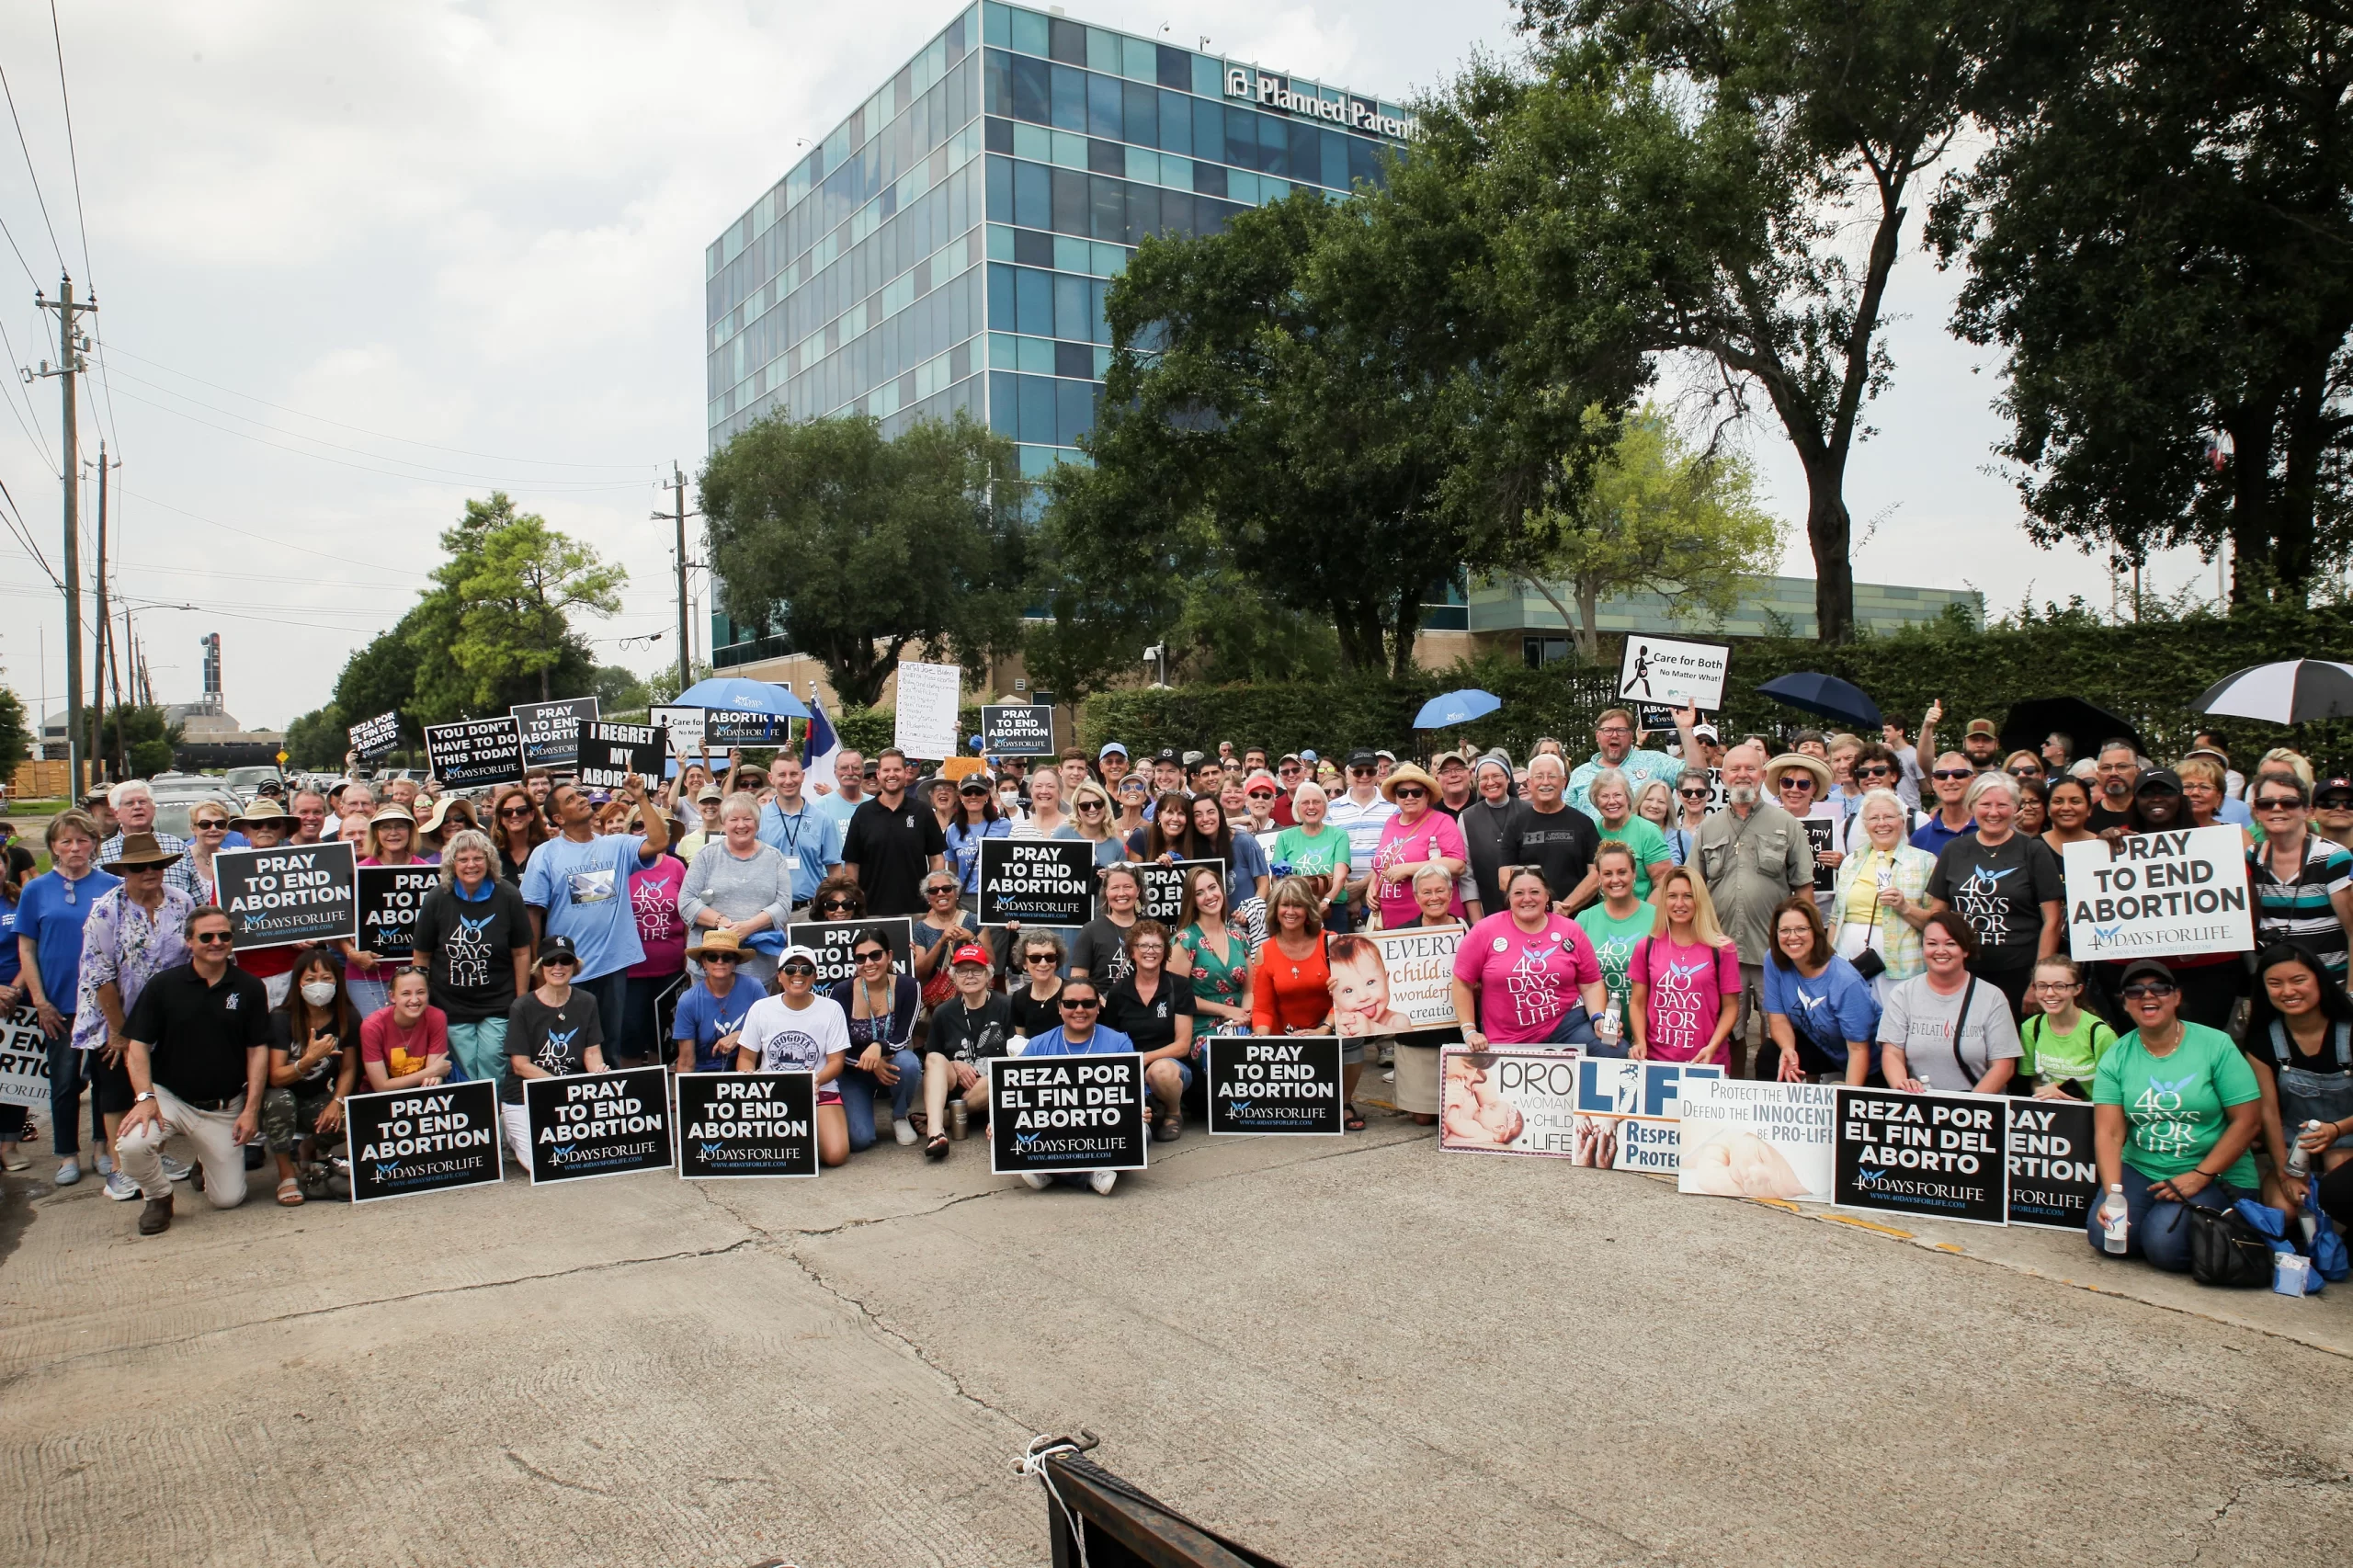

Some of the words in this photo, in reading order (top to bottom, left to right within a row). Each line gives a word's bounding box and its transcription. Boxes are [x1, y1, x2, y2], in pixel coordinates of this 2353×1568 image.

[1259, 77, 1344, 123] Planned
[920, 664, 935, 675] Joe
[937, 666, 954, 677] Biden
[1654, 653, 1677, 664] Care
[1680, 655, 1695, 666] for
[1698, 658, 1722, 669] Both
[1672, 670, 1697, 678] Matter
[1699, 674, 1721, 682] What!
[536, 705, 574, 720] PRAY
[672, 718, 690, 726] Care
[693, 718, 703, 726] for
[1002, 710, 1032, 719] PRAY
[349, 719, 373, 736] REZA
[375, 711, 396, 729] POR
[350, 733, 363, 745] EL
[364, 727, 379, 742] FIN
[380, 722, 400, 737] DEL
[434, 726, 464, 740] YOU
[468, 722, 511, 734] DON'T
[529, 721, 551, 732] TO
[553, 716, 582, 729] END
[590, 722, 596, 740] I
[599, 724, 655, 744] REGRET
[988, 728, 1048, 736] ABORTION
[996, 719, 1013, 728] TO
[1016, 719, 1039, 728] END
[357, 730, 397, 752] ABORTO
[432, 740, 471, 754] HAVE
[474, 737, 494, 748] TO
[497, 733, 517, 745] DO
[899, 743, 915, 755] Stop
[915, 744, 927, 754] the
[434, 753, 469, 766] THIS
[472, 746, 518, 761] TODAY
[609, 747, 633, 765] MY
[456, 768, 479, 778] DAYS
[479, 766, 498, 776] FOR
[1813, 828, 1831, 839] my
[1013, 846, 1062, 861] PRAY
[2109, 831, 2192, 862] PRAY
[256, 853, 316, 873] PRAY
[1002, 862, 1028, 877] TO
[1032, 863, 1072, 878] END
[244, 875, 278, 892] TO
[283, 870, 331, 889] END
[986, 878, 1086, 894] ABORTION
[1959, 873, 1997, 899] 40
[2093, 867, 2136, 893] TO
[2145, 859, 2214, 889] END
[229, 885, 352, 913] ABORTION
[382, 892, 413, 907] TO
[633, 884, 663, 903] 40
[1009, 901, 1035, 912] DAYS
[1035, 903, 1058, 913] FOR
[1057, 903, 1080, 913] LIFE
[1953, 895, 2009, 915] DAYS
[2072, 886, 2245, 925] ABORTION
[261, 916, 291, 930] DAYS
[292, 914, 318, 926] FOR
[317, 910, 347, 923] LIFE
[449, 924, 482, 947] 40
[2114, 931, 2154, 947] DAYS
[2156, 928, 2196, 944] FOR
[2195, 926, 2232, 941] LIFE
[445, 943, 493, 960] DAYS
[813, 948, 842, 962] TO
[1385, 935, 1461, 960] EVERY
[1595, 939, 1628, 959] 40
[449, 959, 488, 974] FOR
[1392, 959, 1441, 983] child
[1442, 967, 1451, 978] is
[1511, 955, 1547, 979] 40
[449, 971, 490, 987] LIFE
[1506, 972, 1561, 994] DAYS
[1656, 970, 1692, 994] 40
[1514, 988, 1561, 1010] FOR
[1654, 990, 1702, 1010] DAYS
[1657, 1009, 1699, 1029] FOR
[773, 1034, 814, 1049] BOGOTÁ
[1655, 1027, 1695, 1049] LIFE
[538, 1039, 569, 1062] 40
[1246, 1046, 1303, 1062] PRAY
[2041, 1053, 2064, 1063] Friends
[1003, 1067, 1071, 1087] REZA
[1078, 1064, 1131, 1085] POR
[1233, 1064, 1264, 1080] TO
[1269, 1064, 1315, 1080] END
[1499, 1061, 1574, 1096] PRO
[566, 1079, 628, 1102] PRAY
[716, 1082, 776, 1099] PRAY
[1001, 1090, 1031, 1108] EL
[1038, 1088, 1078, 1108] FIN
[1086, 1086, 1134, 1106] DEL
[1218, 1082, 1334, 1098] ABORTION
[1762, 1088, 1782, 1103] THE
[1787, 1085, 1834, 1106] WEAK
[391, 1094, 455, 1119] PRAY
[554, 1104, 587, 1123] TO
[593, 1097, 642, 1119] END
[703, 1103, 735, 1119] TO
[741, 1101, 789, 1119] END
[1519, 1096, 1574, 1110] WOMAN
[2133, 1086, 2181, 1115] 40
[1014, 1107, 1121, 1130] ABORTO
[1245, 1108, 1274, 1119] DAYS
[1275, 1108, 1302, 1119] FOR
[1301, 1108, 1326, 1119] LIFE
[1533, 1113, 1574, 1128] CHILD
[1683, 1099, 1725, 1119] DEFEND
[1729, 1107, 1749, 1121] THE
[1753, 1104, 1834, 1126] INNOCENT
[1848, 1098, 1925, 1124] REZA
[1932, 1106, 1993, 1130] POR
[378, 1120, 412, 1140] TO
[419, 1112, 469, 1134] END
[538, 1114, 663, 1144] ABORTION
[688, 1119, 807, 1140] ABORTION
[1756, 1128, 1768, 1141] BE
[360, 1128, 490, 1162] ABORTION
[1033, 1139, 1066, 1153] DAYS
[1068, 1138, 1097, 1151] FOR
[1097, 1137, 1127, 1150] LIFE
[1533, 1132, 1573, 1152] LIFE
[1845, 1121, 1879, 1142] EL
[1886, 1124, 1931, 1148] FIN
[1940, 1130, 1996, 1153] DEL
[2009, 1131, 2072, 1156] END
[569, 1148, 601, 1163] DAYS
[601, 1144, 630, 1158] FOR
[630, 1141, 656, 1155] LIFE
[716, 1149, 745, 1160] DAYS
[747, 1148, 775, 1160] FOR
[775, 1148, 801, 1159] LIFE
[1027, 1152, 1111, 1161] WWW.40DAYSFORLIFE.COM
[1858, 1144, 1980, 1175] ABORTO
[392, 1164, 425, 1180] DAYS
[427, 1161, 455, 1175] FOR
[453, 1155, 483, 1170] LIFE
[1878, 1177, 1915, 1194] DAYS
[1916, 1182, 1949, 1199] FOR
[1950, 1186, 1985, 1202] LIFE
[2013, 1188, 2048, 1206] FOR
[2049, 1193, 2085, 1210] LIFE
[1870, 1192, 1966, 1209] WWW.40DAYSFORLIFE.COM
